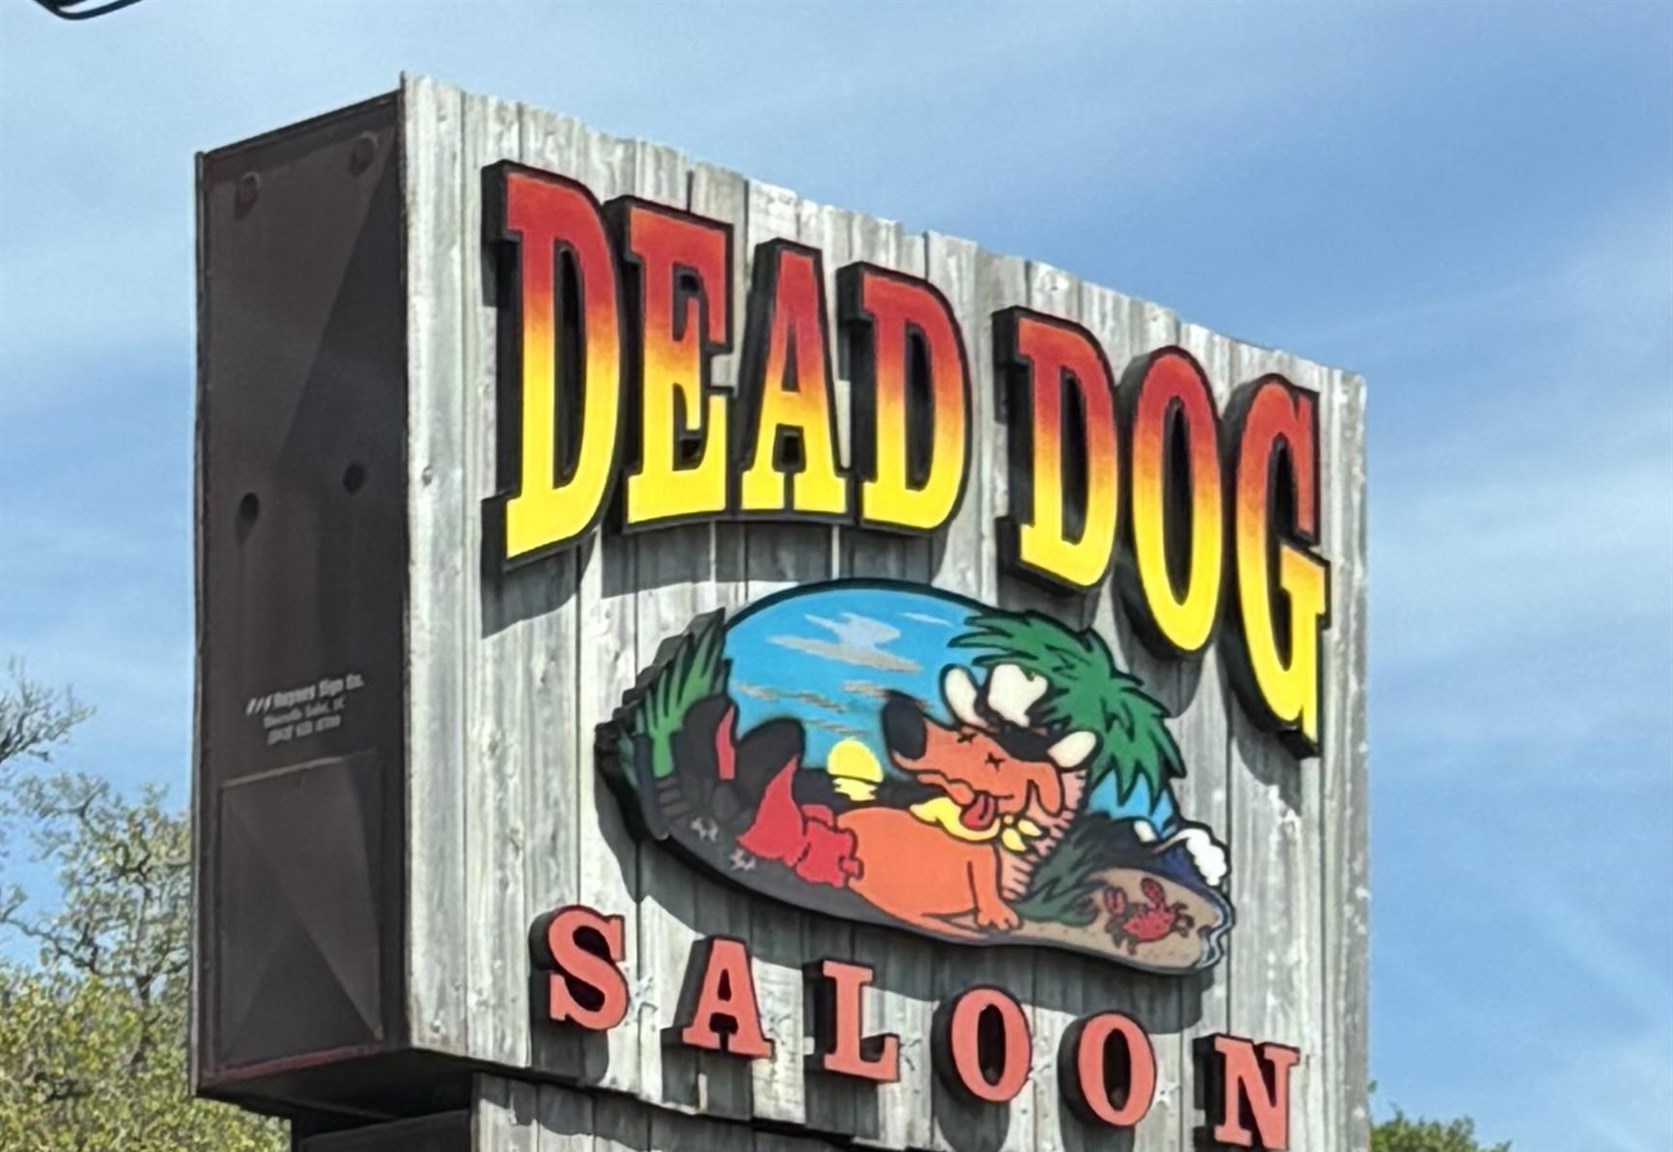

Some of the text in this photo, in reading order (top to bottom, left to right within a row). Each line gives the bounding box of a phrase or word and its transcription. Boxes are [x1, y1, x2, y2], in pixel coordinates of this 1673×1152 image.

[484, 160, 1332, 760] DEAD DOG
[532, 905, 1302, 1152] SALOON
